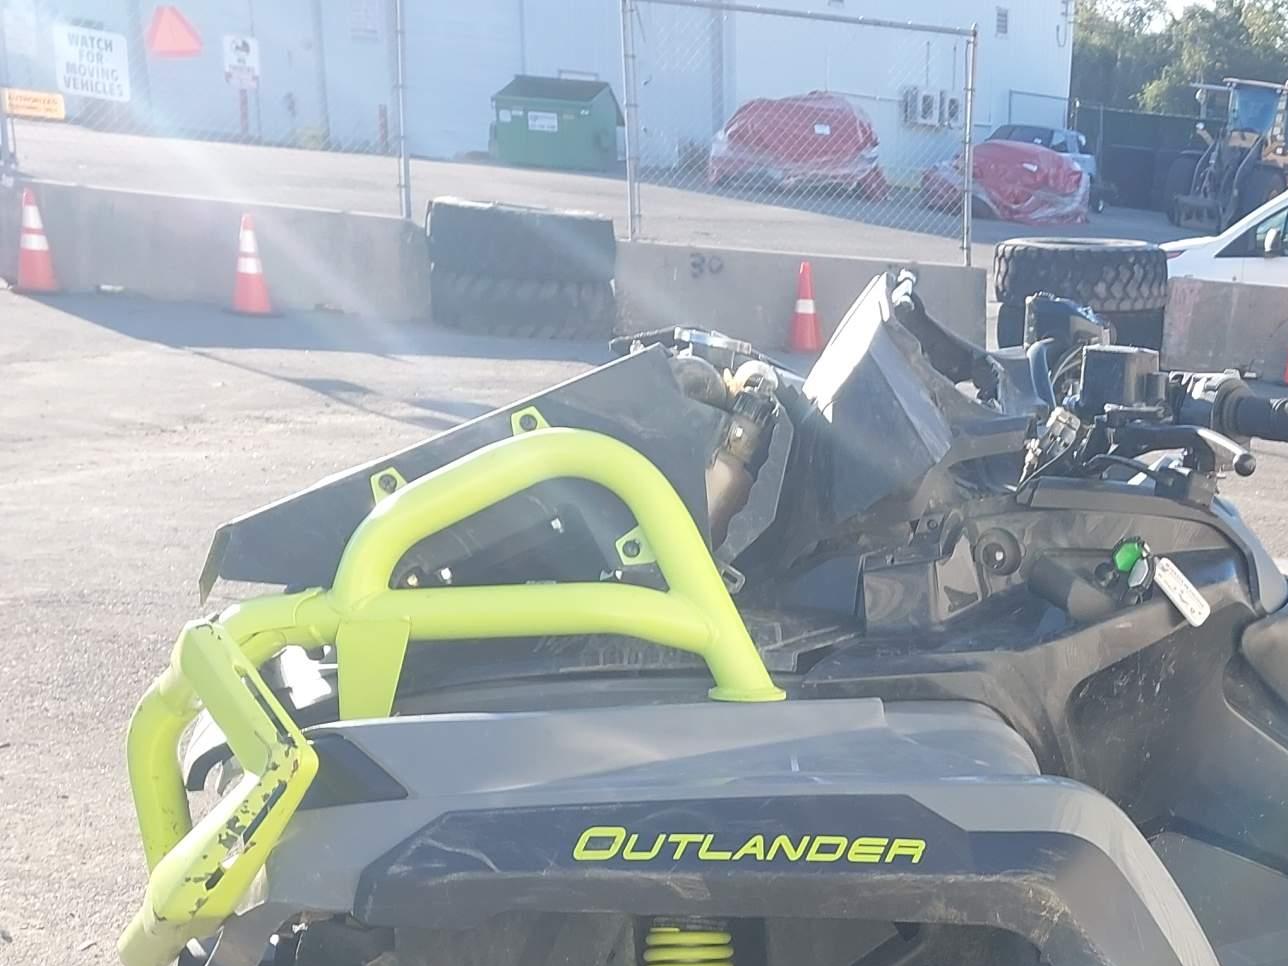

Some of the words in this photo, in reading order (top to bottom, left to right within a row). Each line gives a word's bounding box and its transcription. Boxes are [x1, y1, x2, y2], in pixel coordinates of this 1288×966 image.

[67, 32, 113, 53] WATCH
[78, 48, 105, 65] FOR
[65, 61, 119, 82] MOVING
[63, 76, 124, 97] VEHICLES
[689, 252, 724, 279] 30
